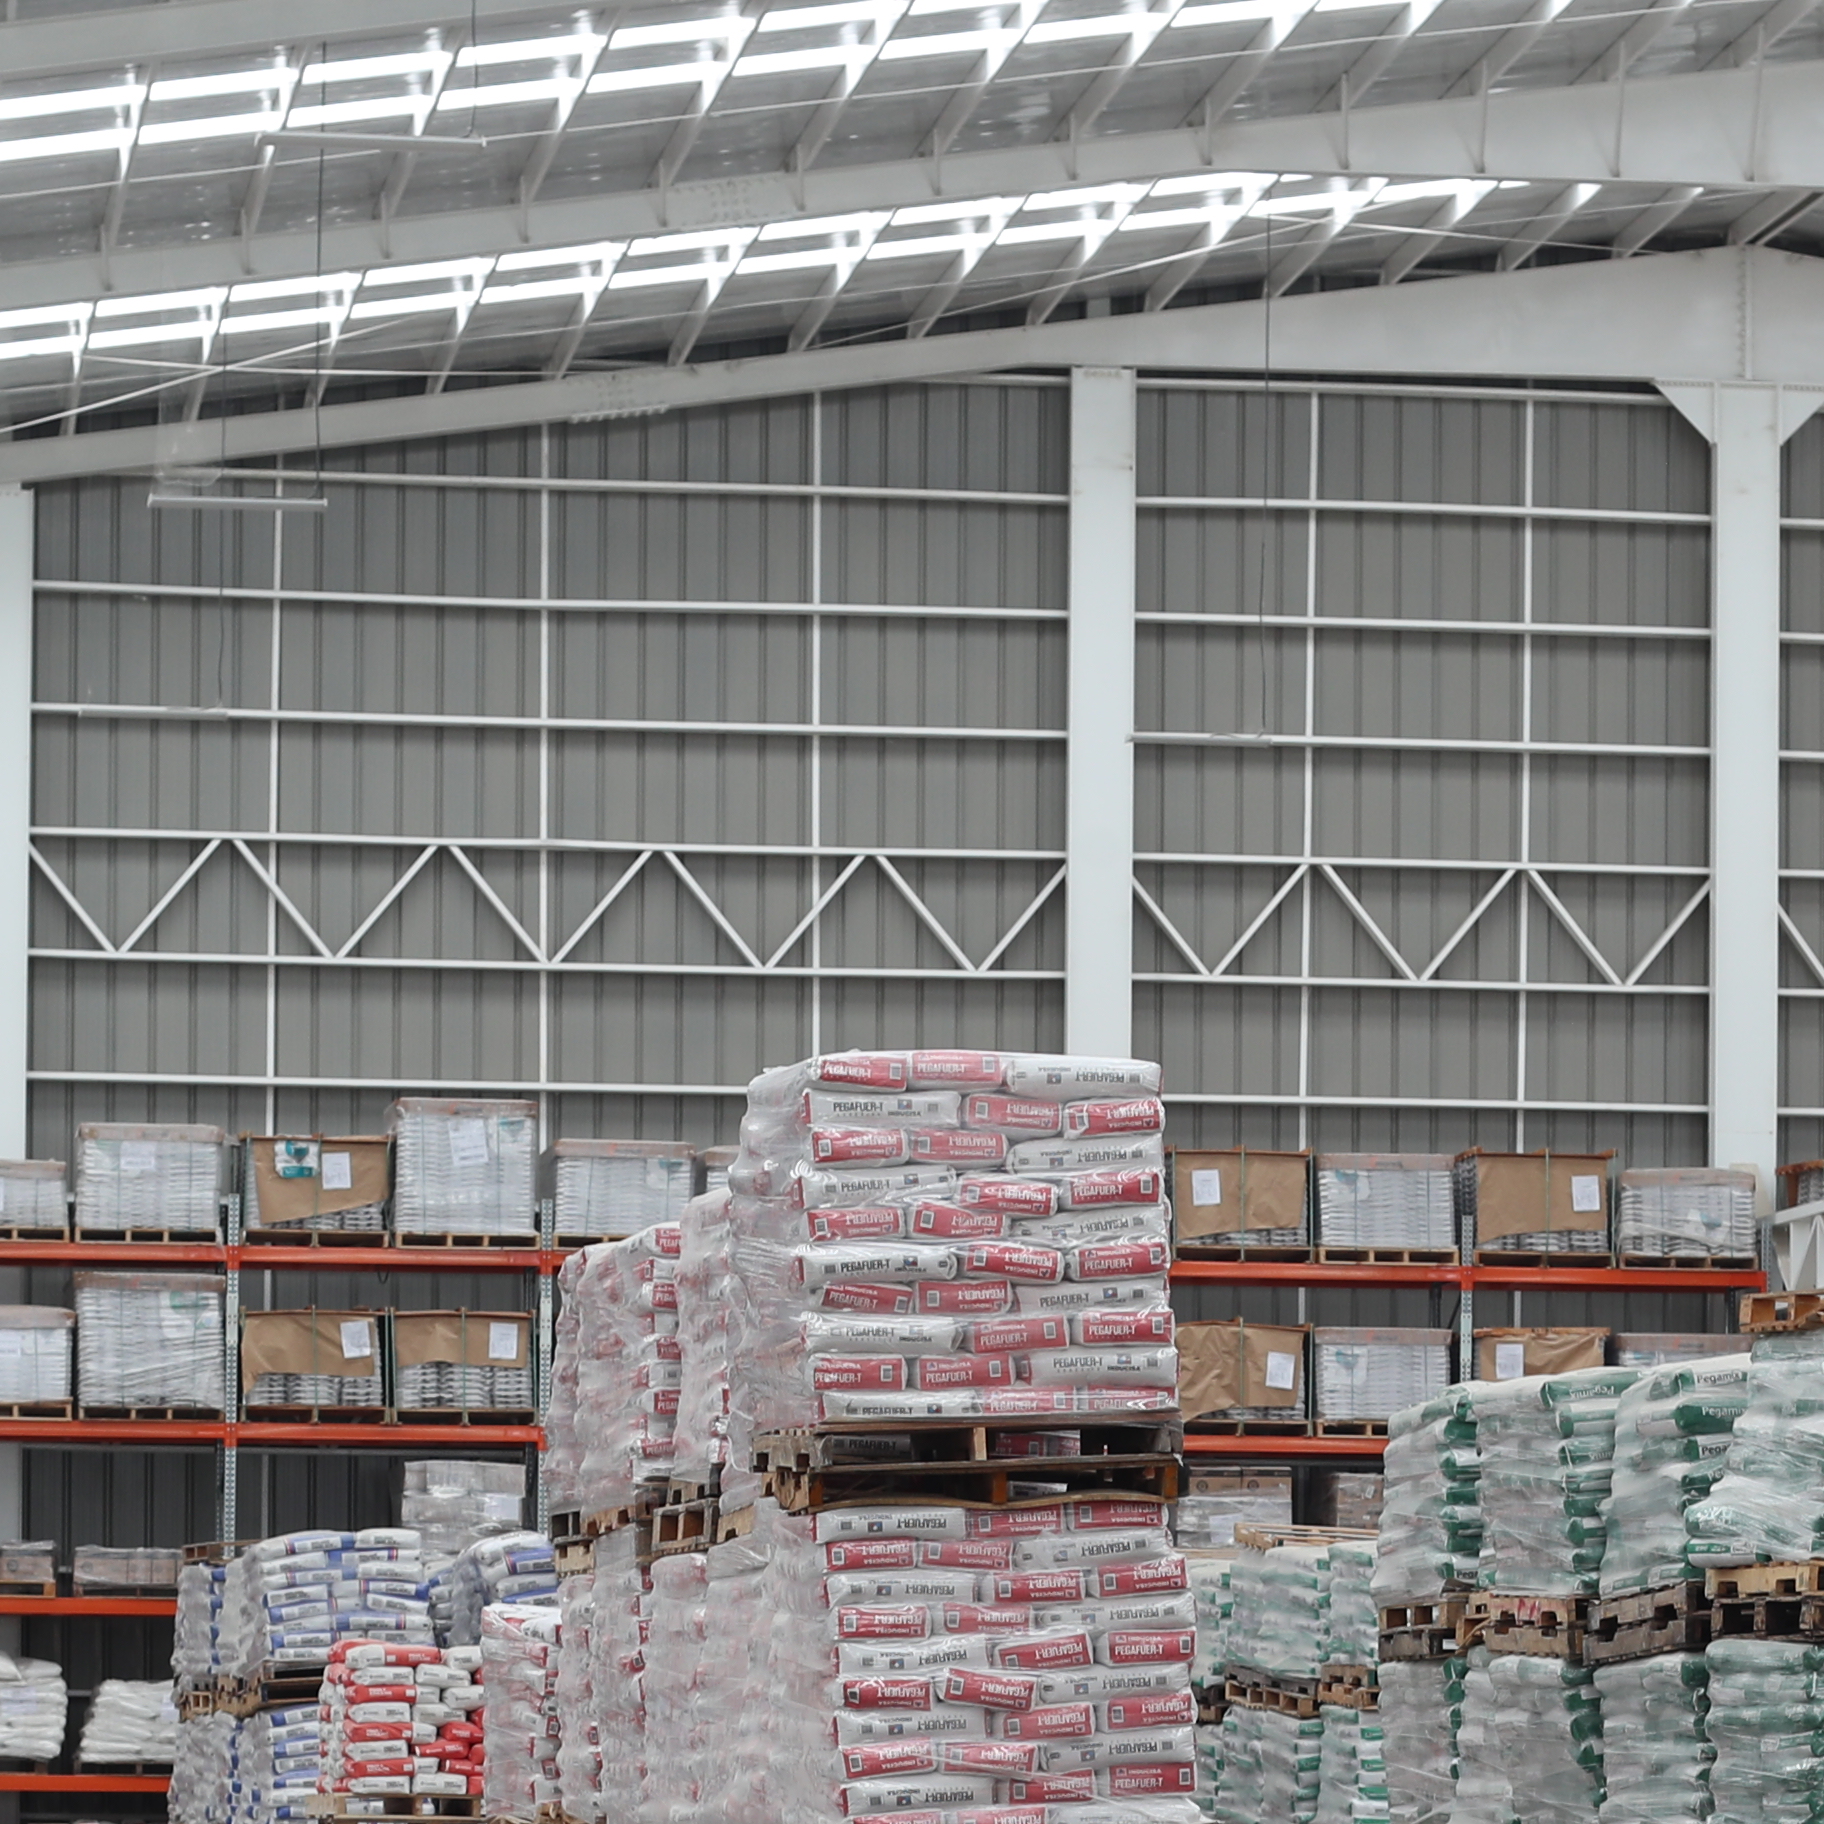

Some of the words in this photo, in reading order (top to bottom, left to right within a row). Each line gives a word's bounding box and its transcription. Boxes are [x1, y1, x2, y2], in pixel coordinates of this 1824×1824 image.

[917, 1062, 966, 1074] PEGAFUER-T
[833, 1101, 883, 1113] PEGAFUER-T
[1074, 1185, 1123, 1198] PEGAFUER-T
[840, 1260, 891, 1273] PEGAFUER-T
[1085, 1257, 1134, 1270] PEGAFUER-T
[828, 1292, 878, 1308] PEGAFUER-T
[957, 1287, 1006, 1300] PEGAFUER-T
[1040, 1294, 1089, 1307] PEGAFUER-T
[1088, 1324, 1135, 1335] PEGAFUER-T
[980, 1332, 1029, 1346] PEGAFUER-T
[1053, 1357, 1103, 1369] PEGAFUER-T
[815, 1371, 861, 1383] PEGAFUER-T
[925, 1371, 973, 1383] PEGAFUER-T
[1696, 1370, 1741, 1385] Pegamix
[1570, 1386, 1615, 1399] Pegamix
[862, 1406, 914, 1416] PEGAFUER-T
[897, 1518, 947, 1530] PEGAFUER-T
[1081, 1539, 1131, 1557] PEGAFUER-T
[905, 1583, 955, 1596] PEGAFUER-T
[1108, 1607, 1159, 1619] PEGAFUER-T
[918, 1649, 968, 1665] PEGAFUER-T
[1115, 1644, 1164, 1657] PEGAFUER-T
[1101, 1675, 1151, 1688] PEGAFUER-T
[917, 1719, 968, 1731] PEGAFUER-T
[1108, 1741, 1159, 1755] PEGAFUER-T
[1115, 1777, 1163, 1788] PEGAFUER-T
[923, 1790, 974, 1802] PEGAFUER-T
